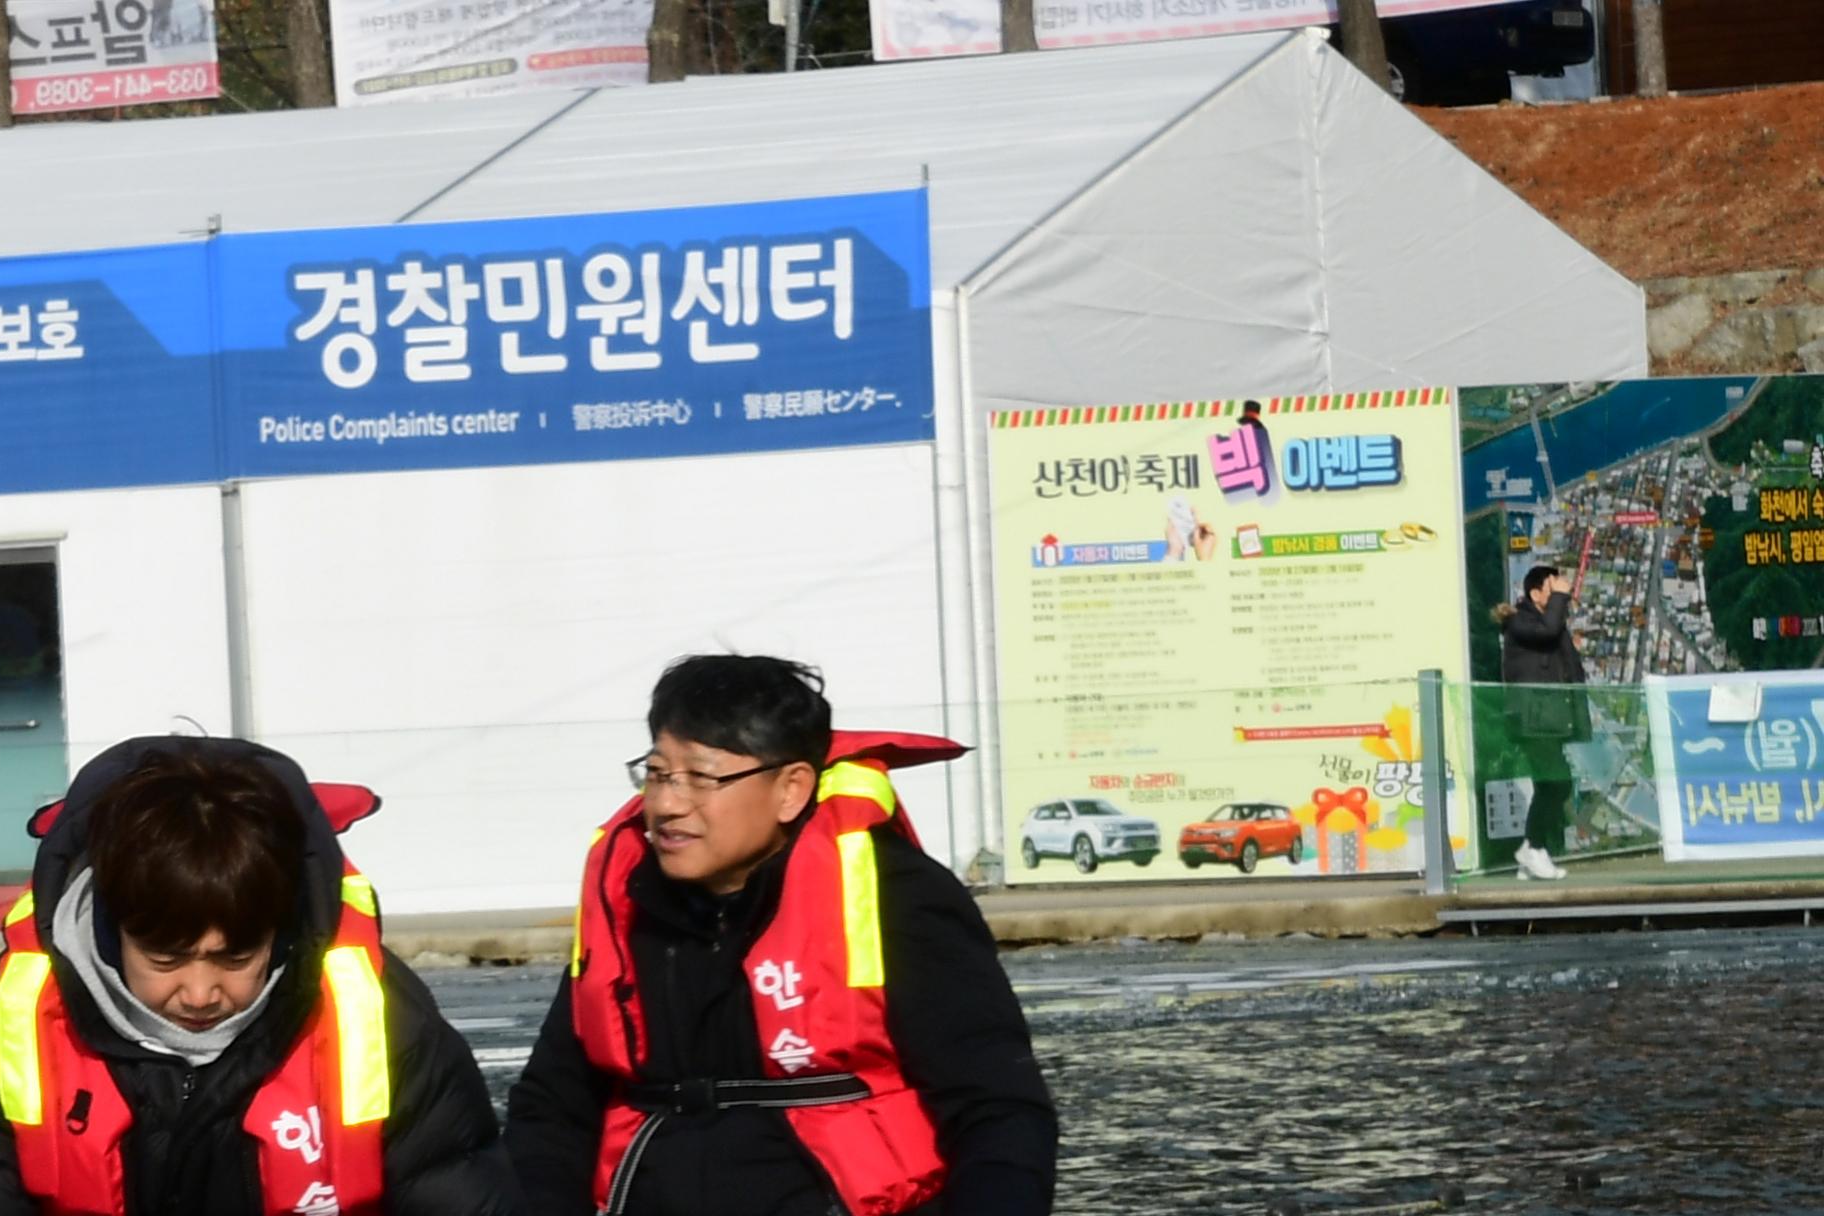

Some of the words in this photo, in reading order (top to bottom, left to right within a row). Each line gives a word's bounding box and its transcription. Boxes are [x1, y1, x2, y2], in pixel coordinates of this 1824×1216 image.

[295, 238, 853, 388] 경찰민원센터
[260, 417, 325, 443] Police
[329, 411, 449, 444] Complaints
[451, 408, 519, 435] center
[1208, 424, 1267, 492] 빅
[1281, 434, 1402, 491] 이벤트
[1339, 532, 1379, 551] 이벤트
